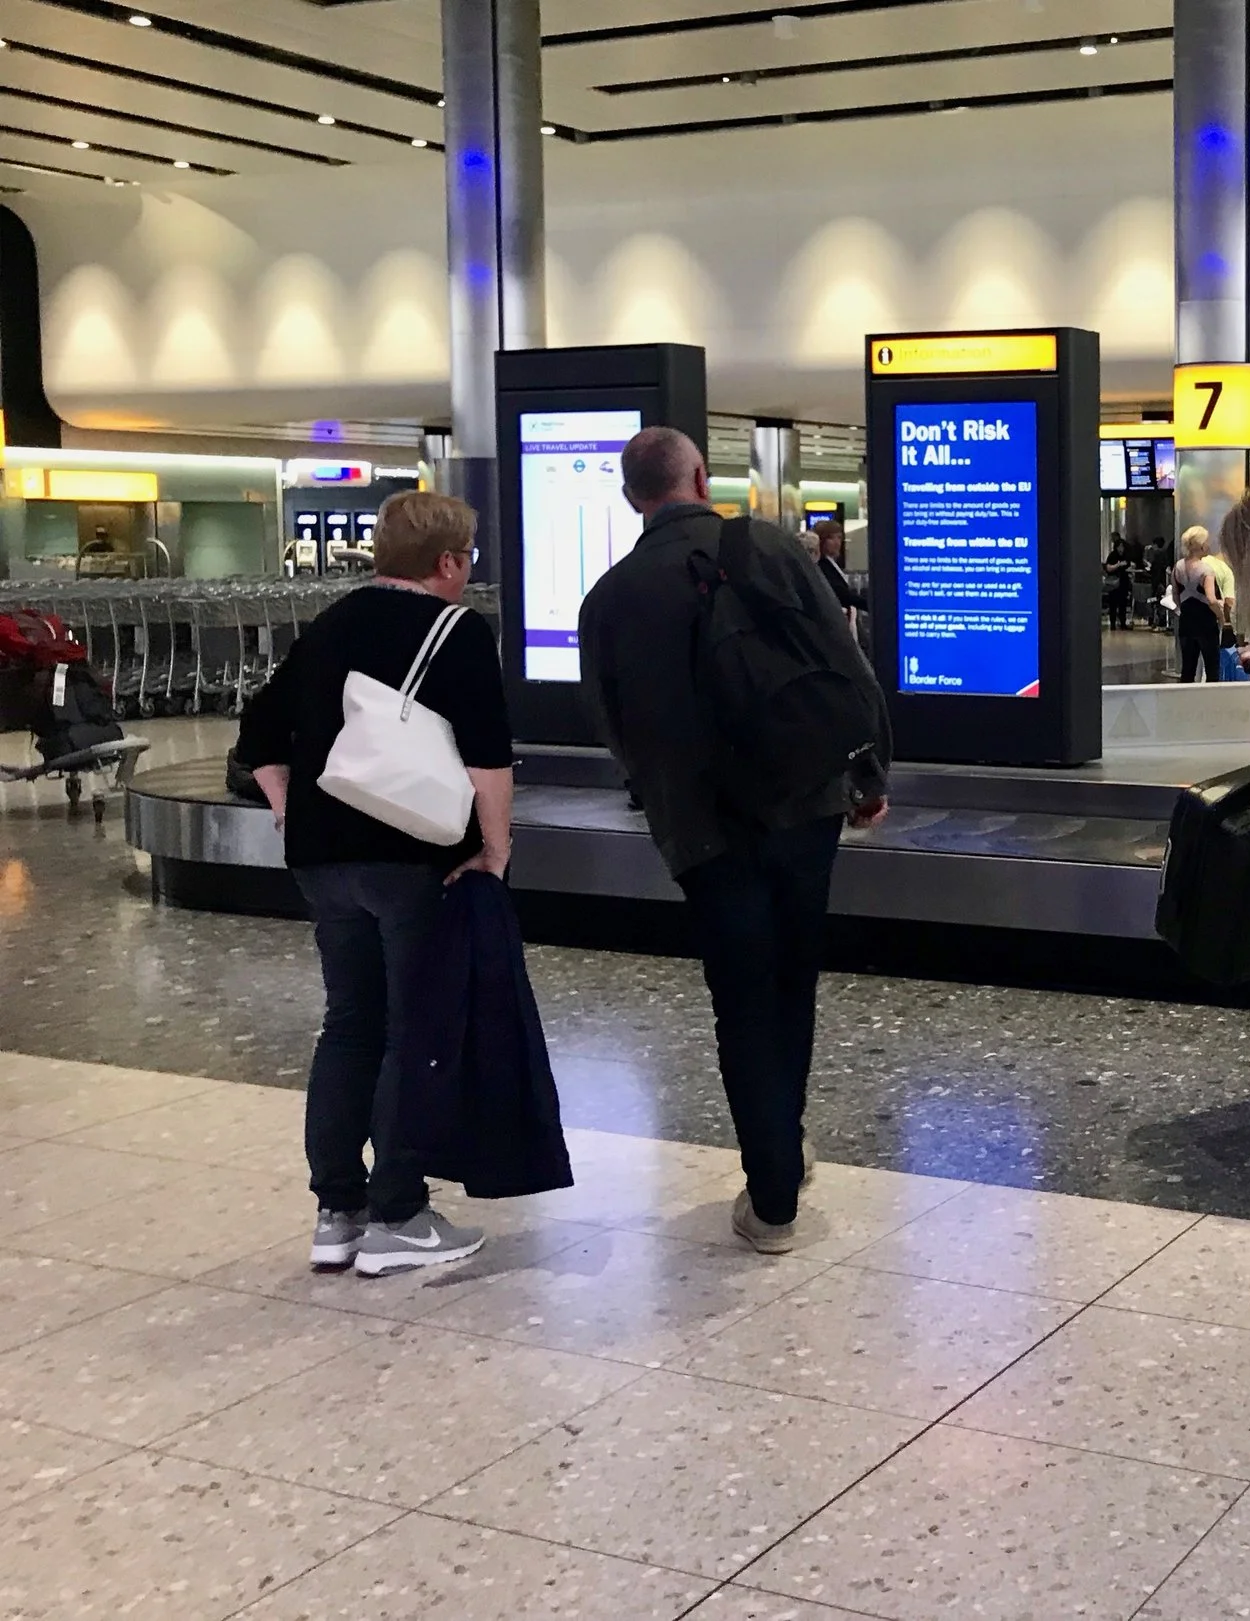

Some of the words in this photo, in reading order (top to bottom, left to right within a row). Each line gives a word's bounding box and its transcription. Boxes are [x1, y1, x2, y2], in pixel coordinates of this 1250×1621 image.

[1194, 381, 1223, 430] 7
[901, 420, 957, 441] Don't
[963, 420, 1010, 441] Risk
[525, 444, 540, 452] LIVE
[541, 444, 568, 452] TRAVEL
[569, 443, 598, 451] UPDATE
[901, 444, 917, 466] It
[923, 444, 971, 466] All...
[902, 482, 944, 494] Travelling
[945, 482, 965, 492] from
[967, 482, 999, 492] outside
[1001, 482, 1016, 492] the
[1018, 482, 1031, 492] EU
[903, 537, 945, 549] Travelling
[946, 537, 967, 547] from
[969, 537, 996, 547] within
[998, 537, 1013, 547] the
[1014, 537, 1028, 547] EU
[909, 674, 937, 685] Border
[939, 675, 963, 686] Force
